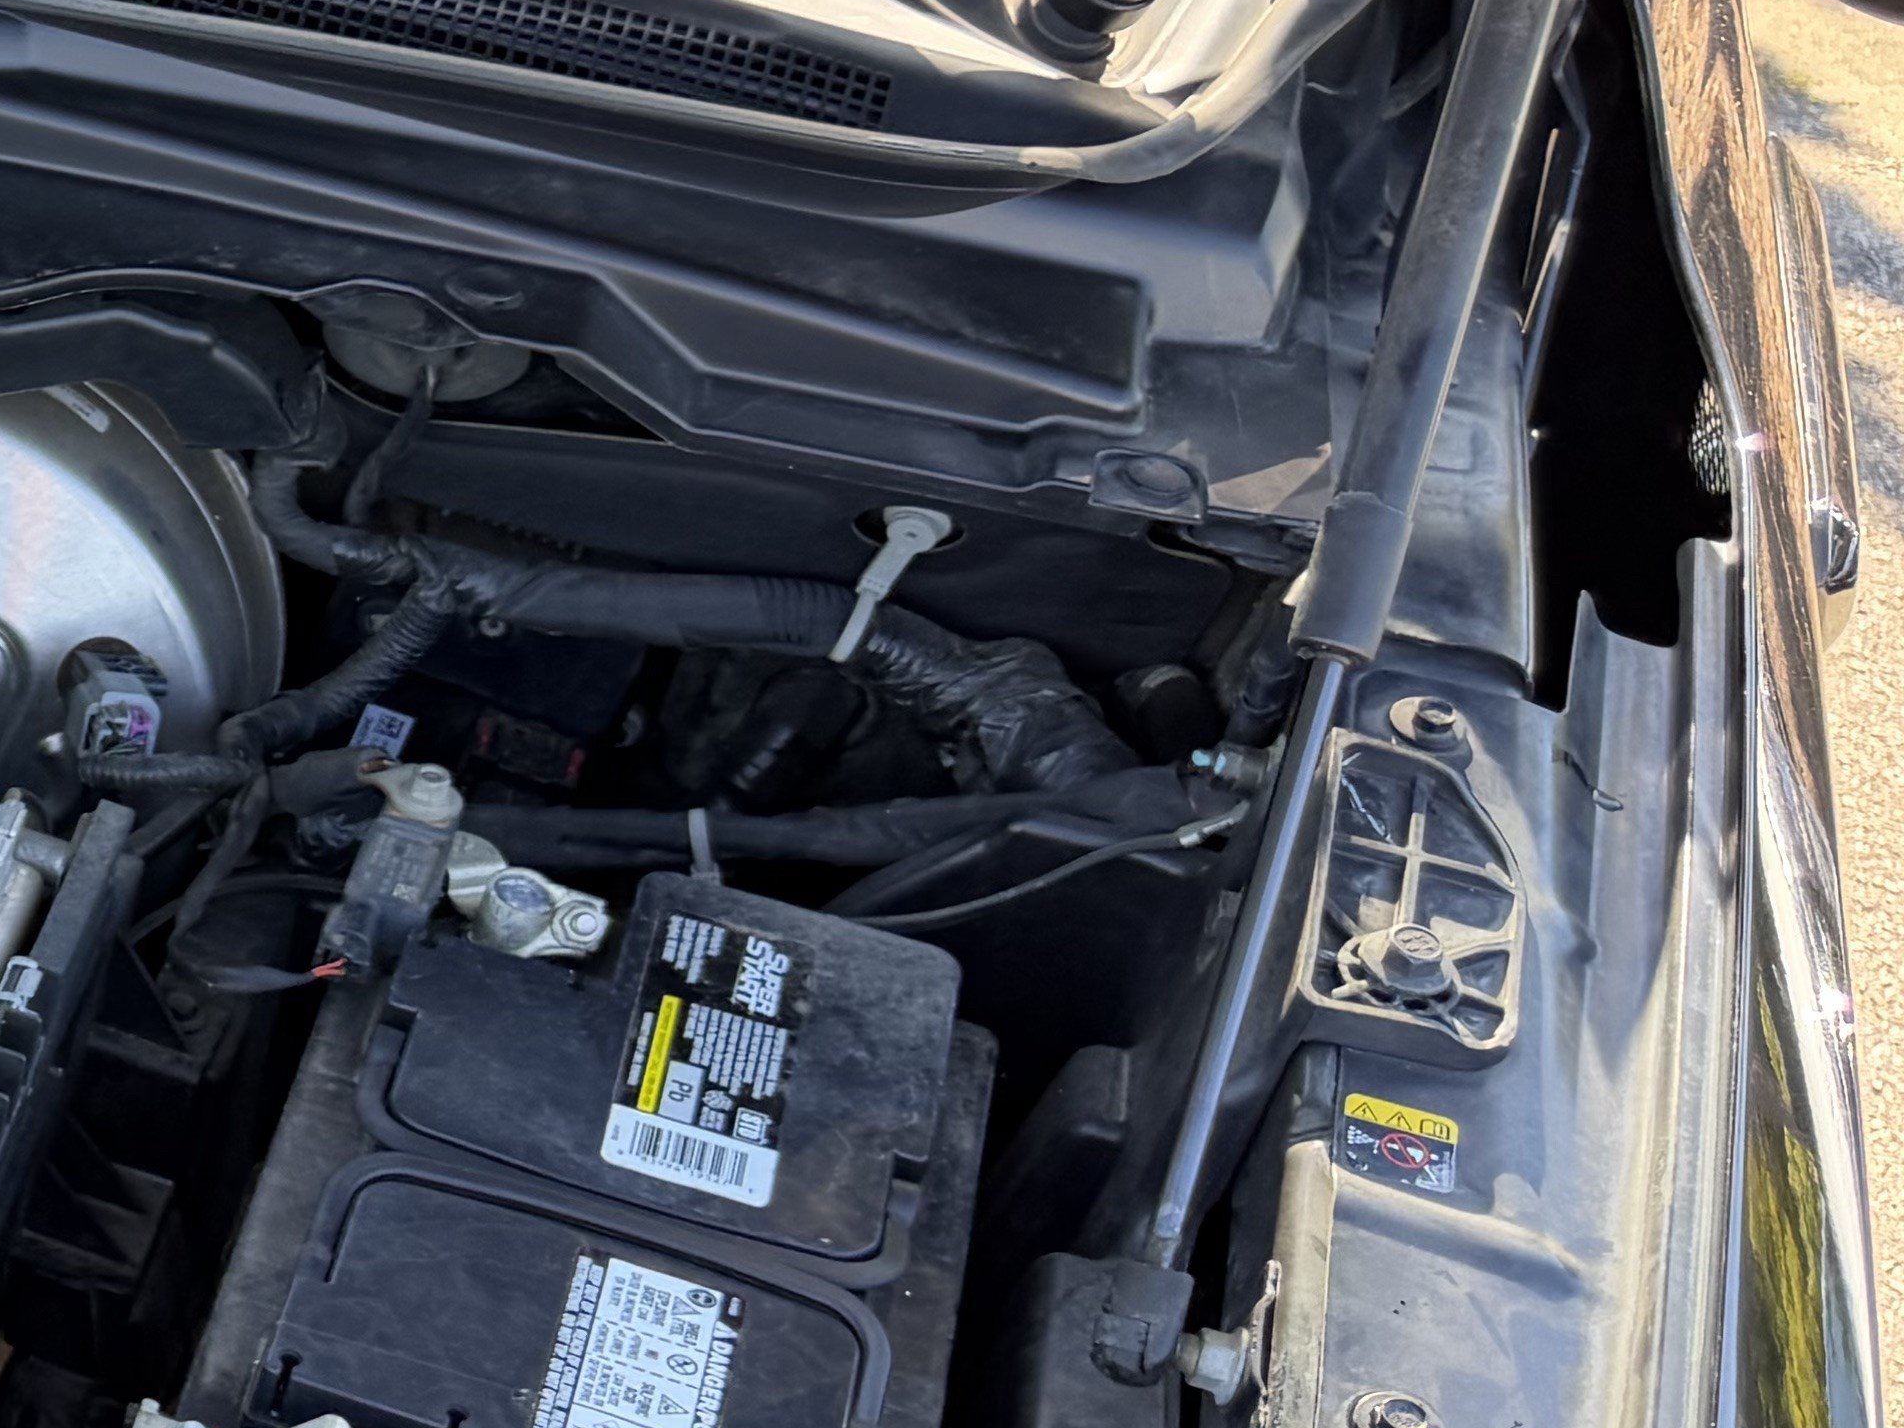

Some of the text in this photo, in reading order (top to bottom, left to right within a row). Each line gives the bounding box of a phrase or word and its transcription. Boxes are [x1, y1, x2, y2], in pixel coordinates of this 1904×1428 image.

[732, 934, 773, 1014] START
[753, 948, 791, 1019] SUPER
[667, 1077, 693, 1106] Pb
